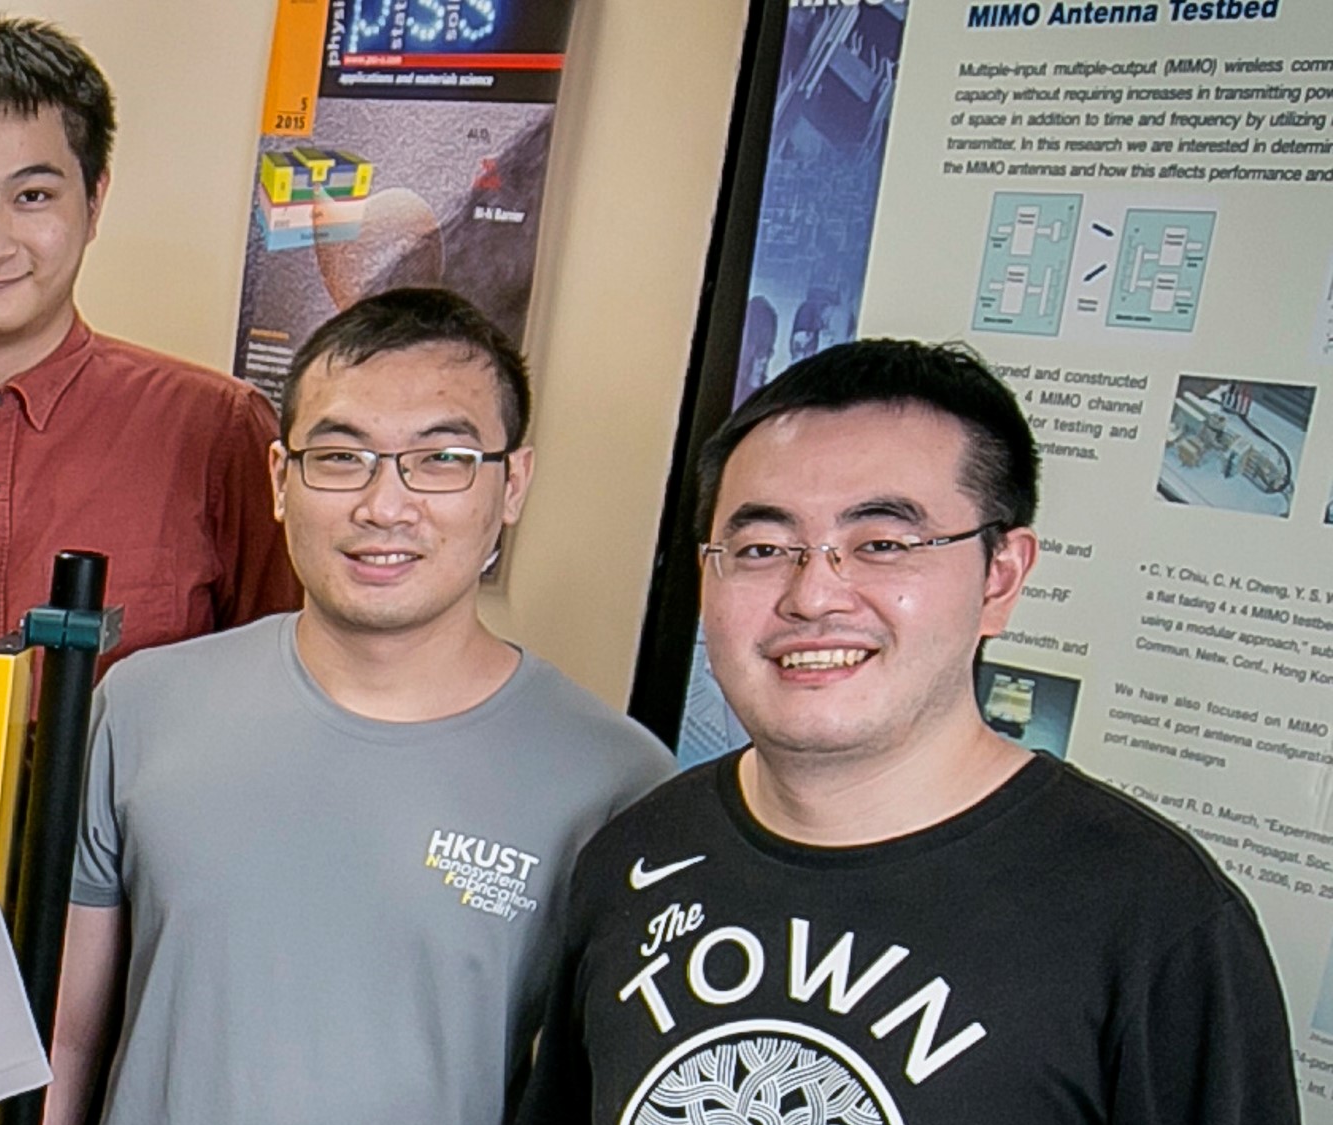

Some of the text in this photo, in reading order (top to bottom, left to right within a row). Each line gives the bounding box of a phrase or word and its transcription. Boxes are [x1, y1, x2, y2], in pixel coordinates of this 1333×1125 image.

[967, 0, 1280, 27] MIMO Antenna Testbed
[959, 62, 1048, 79] Multiple-input
[1053, 61, 1158, 78] multiple-output
[1164, 58, 1218, 76] (MIMO)
[1225, 58, 1283, 73] wireless
[955, 89, 1009, 105] capacity
[1013, 87, 1062, 102] without
[1064, 86, 1123, 104] requiring
[1126, 86, 1193, 101] increases
[1197, 84, 1210, 100] in
[1214, 84, 1302, 104] transmitting
[275, 115, 306, 130] 2015
[950, 111, 1326, 131] of space in addition to time and frequency by utilizing
[1019, 137, 1034, 151] In
[1037, 136, 1061, 151] this
[1064, 138, 1123, 152] research
[1127, 140, 1148, 153] we
[1151, 140, 1173, 153] are
[1177, 138, 1249, 153] interested
[1253, 138, 1267, 153] in
[943, 161, 963, 174] the
[966, 160, 1005, 176] MIMO
[1007, 163, 1067, 177] antennas
[1069, 162, 1096, 177] and
[1098, 163, 1128, 178] how
[1131, 163, 1156, 179] this
[1158, 164, 1206, 180] affects
[1209, 165, 1301, 183] performance
[1035, 368, 1061, 381] and
[1064, 371, 1149, 390] constructed
[1024, 390, 1144, 415] 4 MIMO channel
[1054, 417, 1103, 439] testing
[1109, 425, 1139, 440] and
[1066, 545, 1092, 558] and
[1021, 586, 1072, 602] non-RF
[1179, 594, 1216, 613] fading
[1219, 601, 1227, 612] 4
[1240, 604, 1248, 616] 4
[1252, 606, 1291, 624] MIMO
[1141, 616, 1173, 632] using
[1186, 622, 1237, 640] modular
[1062, 642, 1089, 657] and
[1272, 662, 1308, 683] Hong
[1114, 682, 1329, 738] We have also focused on MIMO
[1109, 708, 1161, 727] compact
[1164, 718, 1172, 729] 4
[1174, 721, 1201, 737] port
[1203, 728, 1253, 748] antenna
[1130, 736, 1177, 757] antenna
[1180, 747, 1226, 767] designs
[1161, 794, 1185, 809] and
[428, 829, 540, 880] HKUST
[425, 853, 526, 894] Nanosystem
[444, 871, 537, 911] Fabrication
[461, 890, 518, 922] Facility
[640, 902, 706, 957] The
[618, 917, 988, 1085] TOWN
